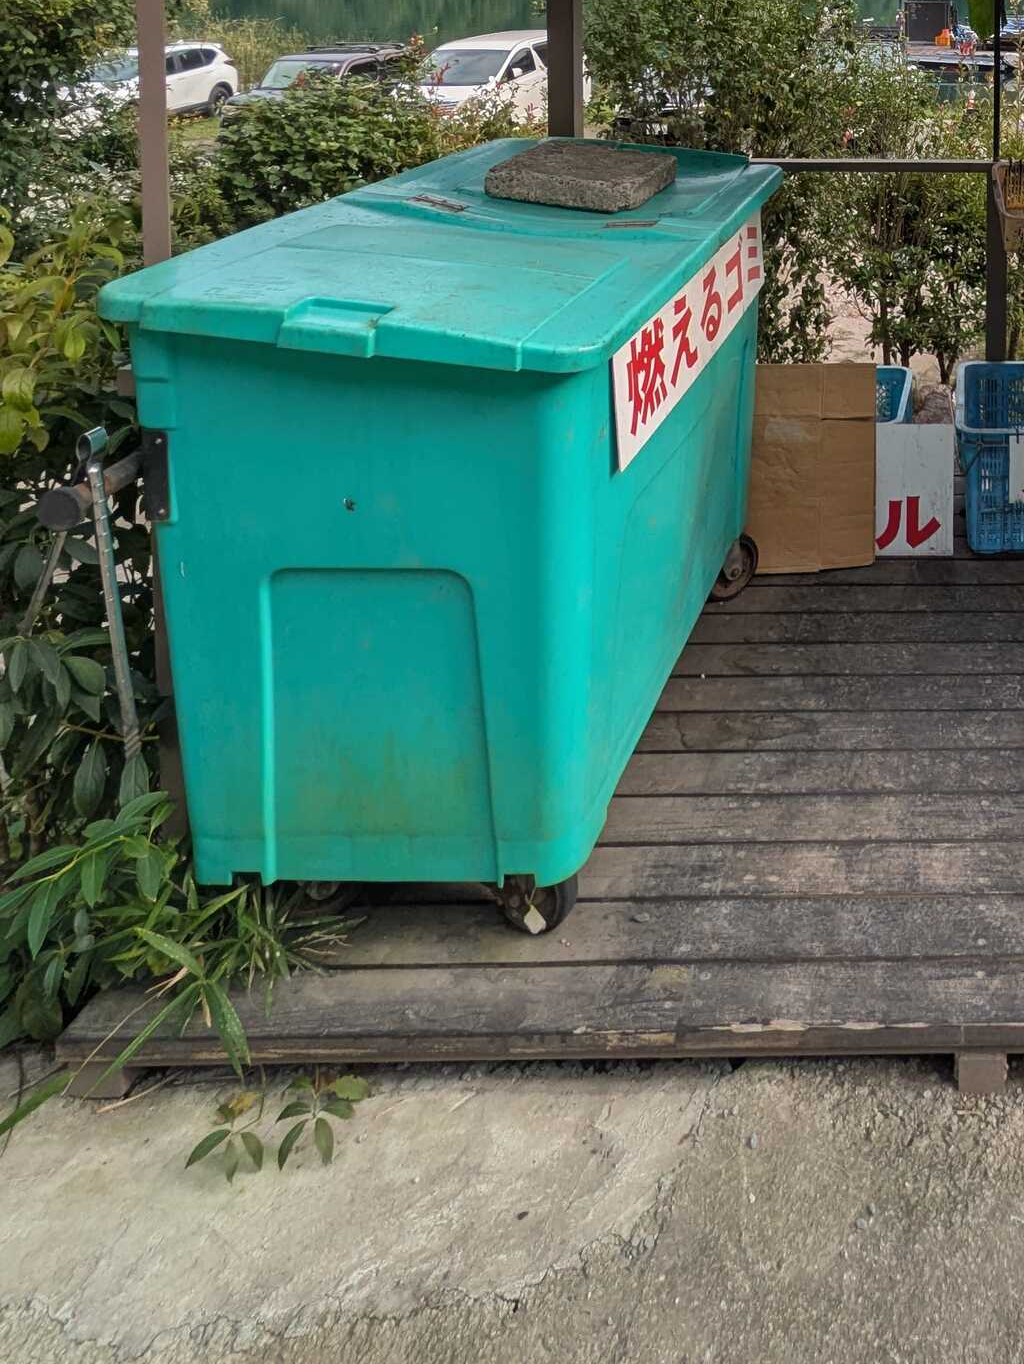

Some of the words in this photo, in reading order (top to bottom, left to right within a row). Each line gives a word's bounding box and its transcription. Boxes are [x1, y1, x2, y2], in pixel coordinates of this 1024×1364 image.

[626, 226, 761, 437] 燃えるゴミ
[875, 496, 942, 550] ル
